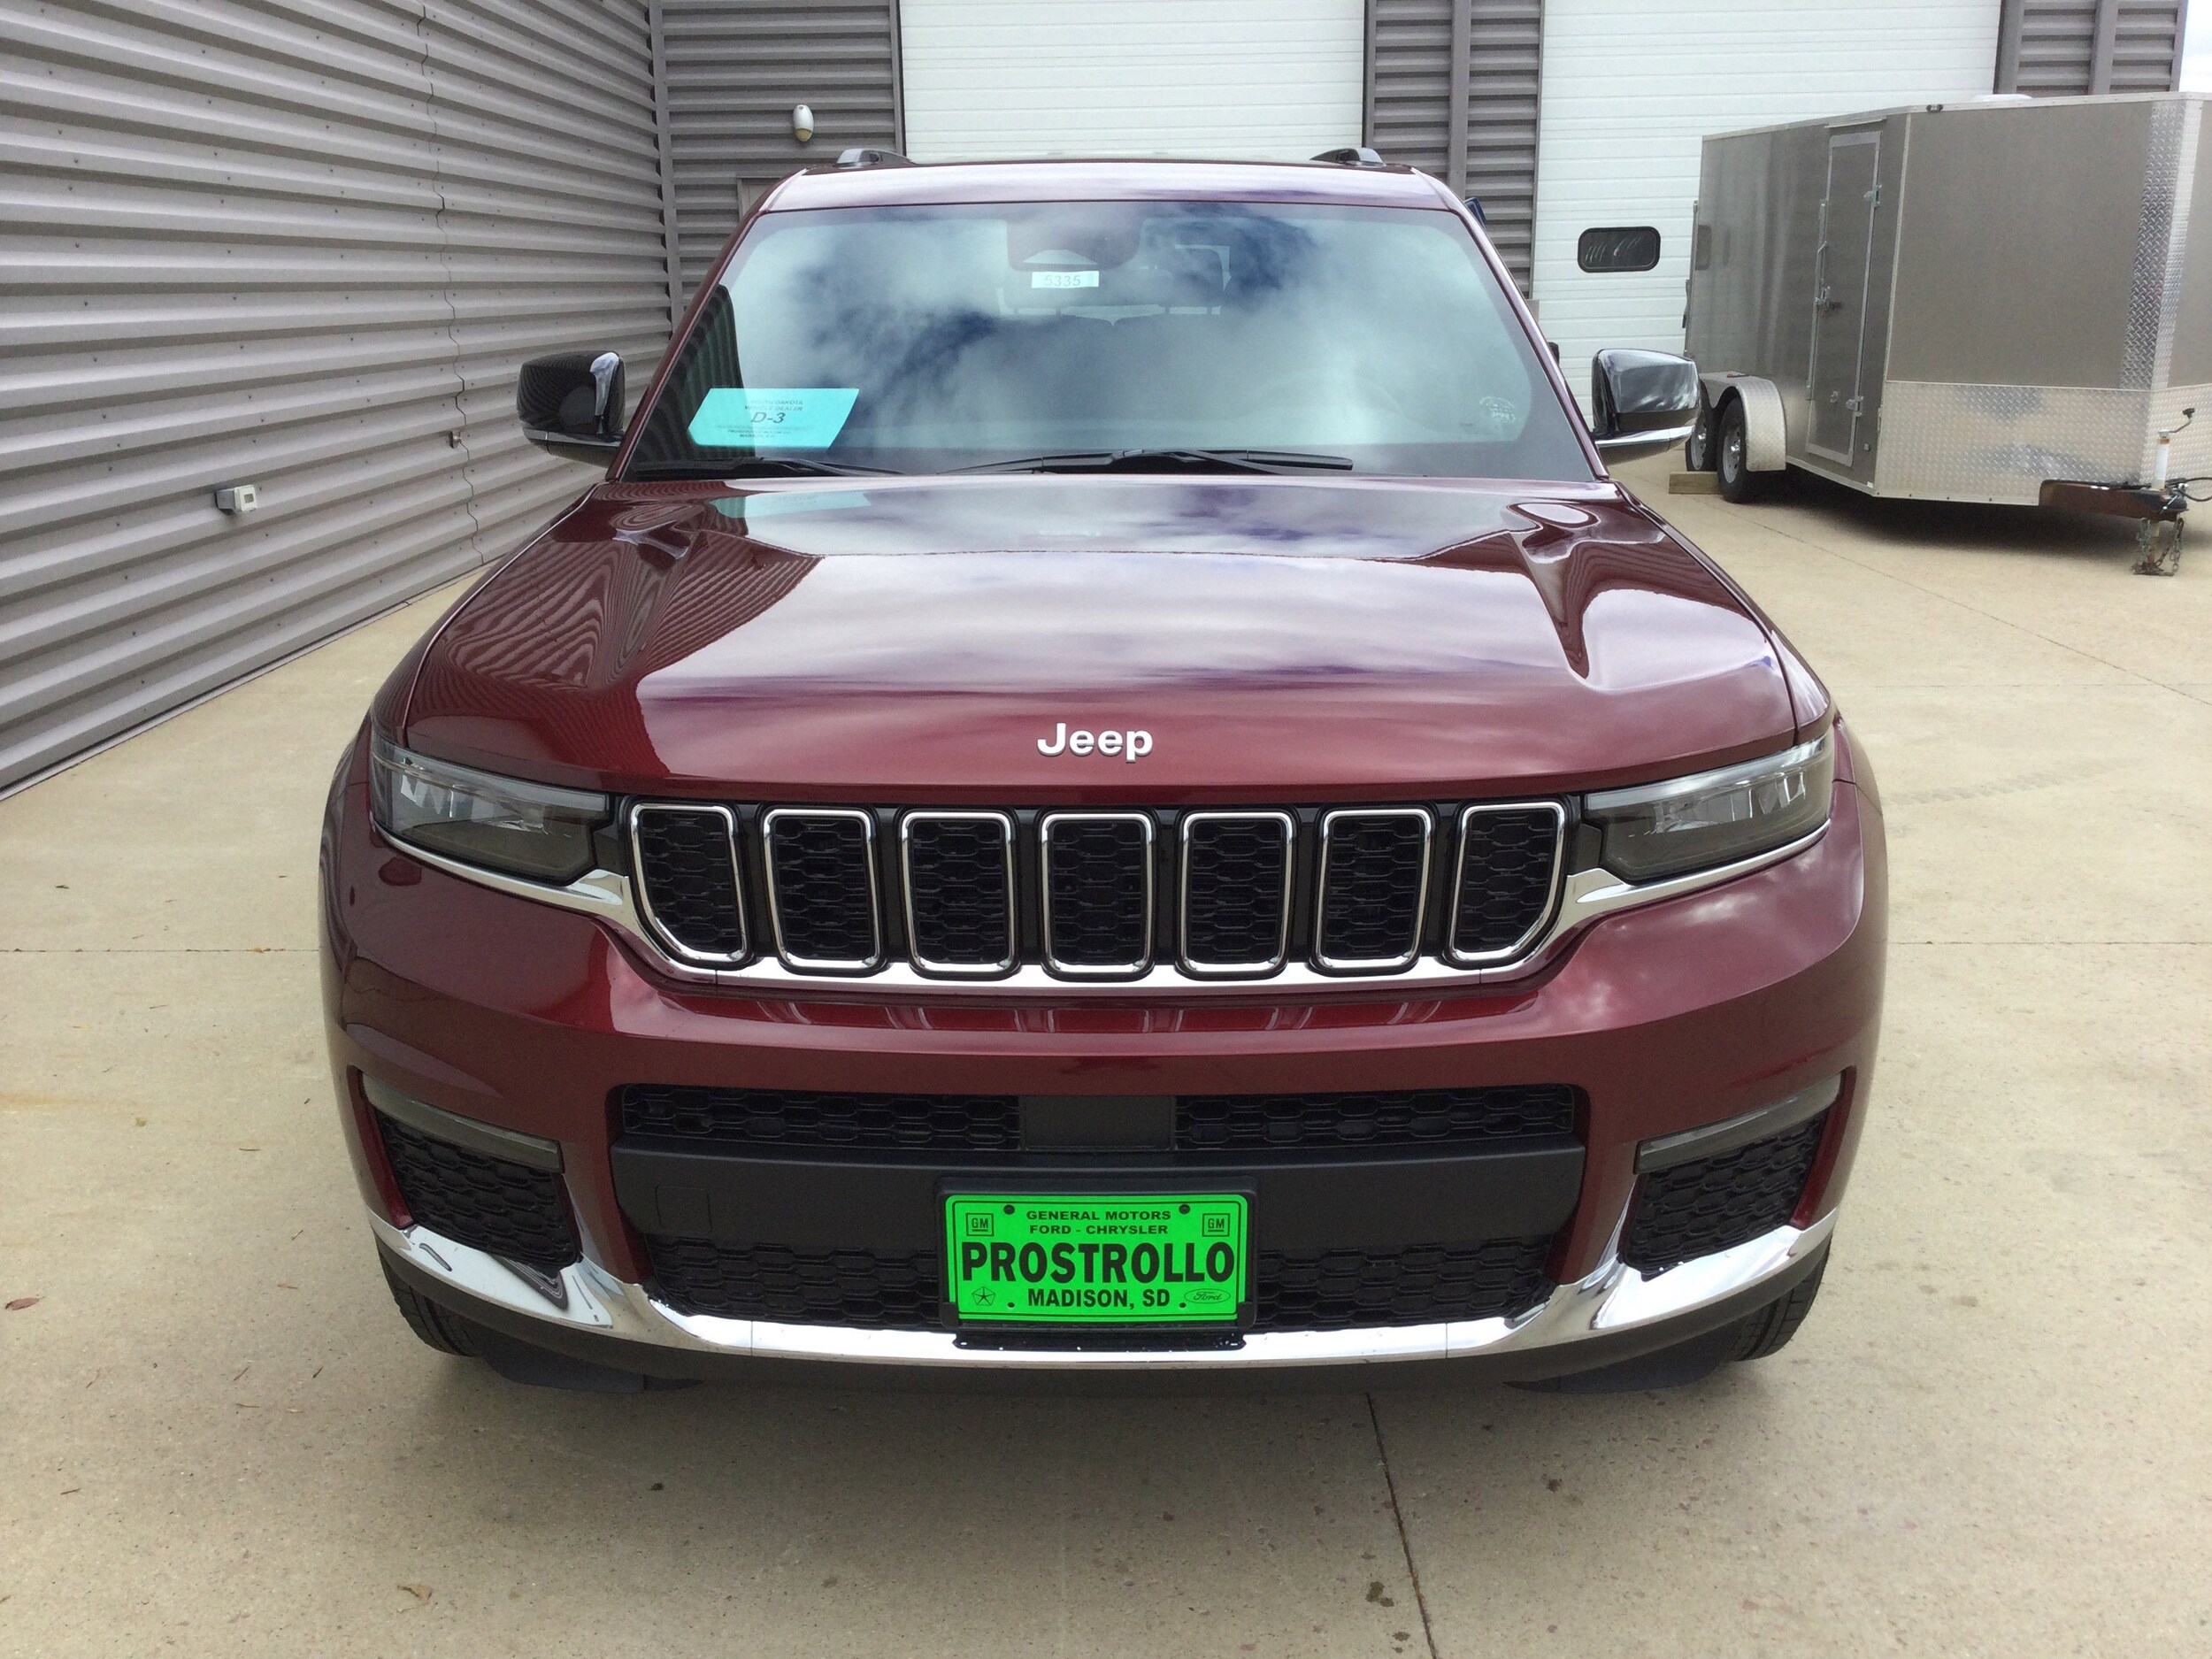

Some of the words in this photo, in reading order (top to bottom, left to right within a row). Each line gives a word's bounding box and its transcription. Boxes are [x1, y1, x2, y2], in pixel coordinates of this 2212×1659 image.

[1044, 274, 1081, 288] 5335
[750, 411, 786, 424] D-3
[1037, 723, 1153, 764] Jeep
[1026, 1210, 1100, 1221] GENERAL
[1105, 1210, 1171, 1220] MOTORS
[972, 1217, 989, 1229] GM
[1030, 1225, 1071, 1234] FORD
[1086, 1225, 1169, 1234] CHRYSLER
[1208, 1217, 1225, 1230] GM
[962, 1241, 1235, 1283] PROSTROLLO
[1027, 1288, 1134, 1310] MADISON,
[1142, 1288, 1170, 1307] SD
[1194, 1290, 1222, 1301] Ford
